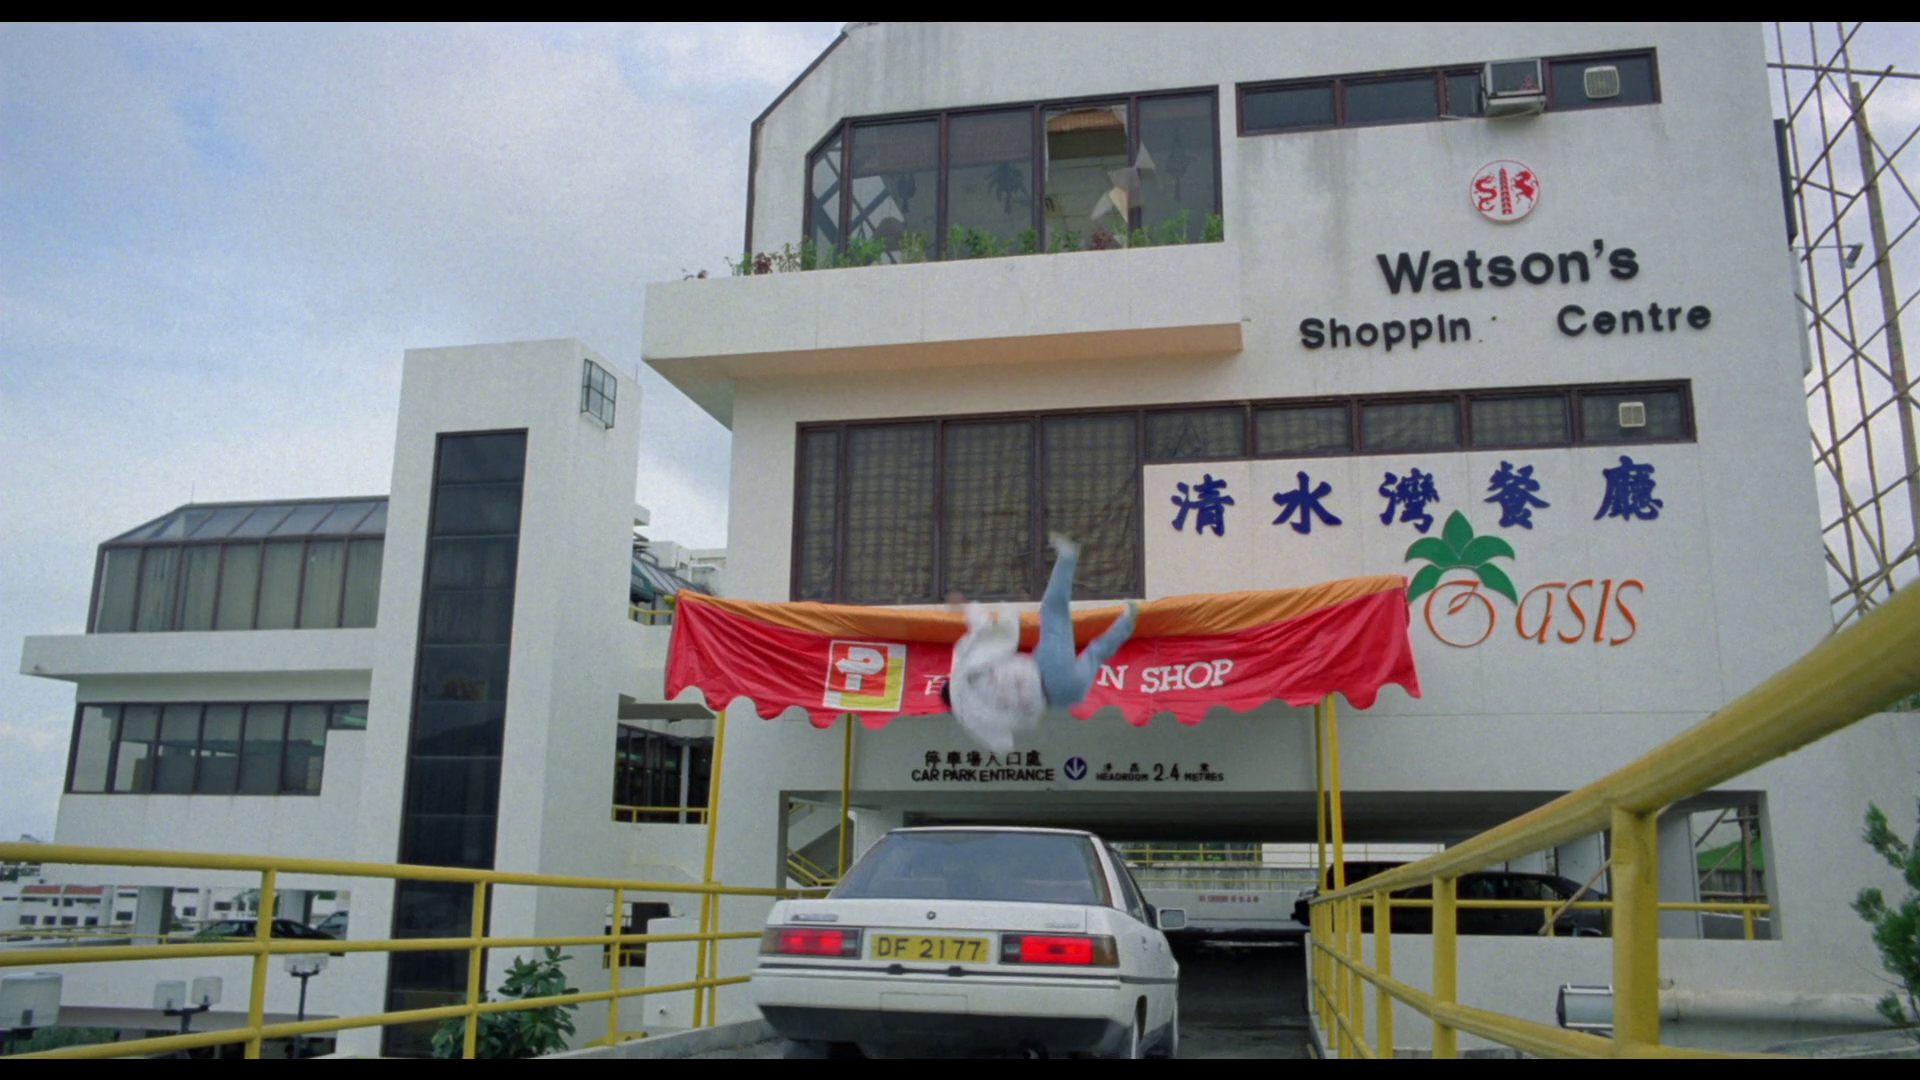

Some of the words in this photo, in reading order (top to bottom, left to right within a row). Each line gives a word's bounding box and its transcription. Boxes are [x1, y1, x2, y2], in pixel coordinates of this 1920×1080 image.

[1377, 239, 1639, 294] Watson's
[1557, 303, 1711, 336] Centre
[1170, 455, 1663, 536] 清水灣餐廳
[1140, 658, 1234, 694] SHOP
[911, 769, 940, 781] CAR
[942, 769, 977, 781] PARK
[979, 768, 1055, 782] ENTRANCE
[1096, 773, 1149, 781] HEADROOM
[1153, 762, 1179, 781] 2.4
[1184, 772, 1225, 781] METRES
[878, 937, 909, 958] DF
[919, 938, 982, 960] 2177
